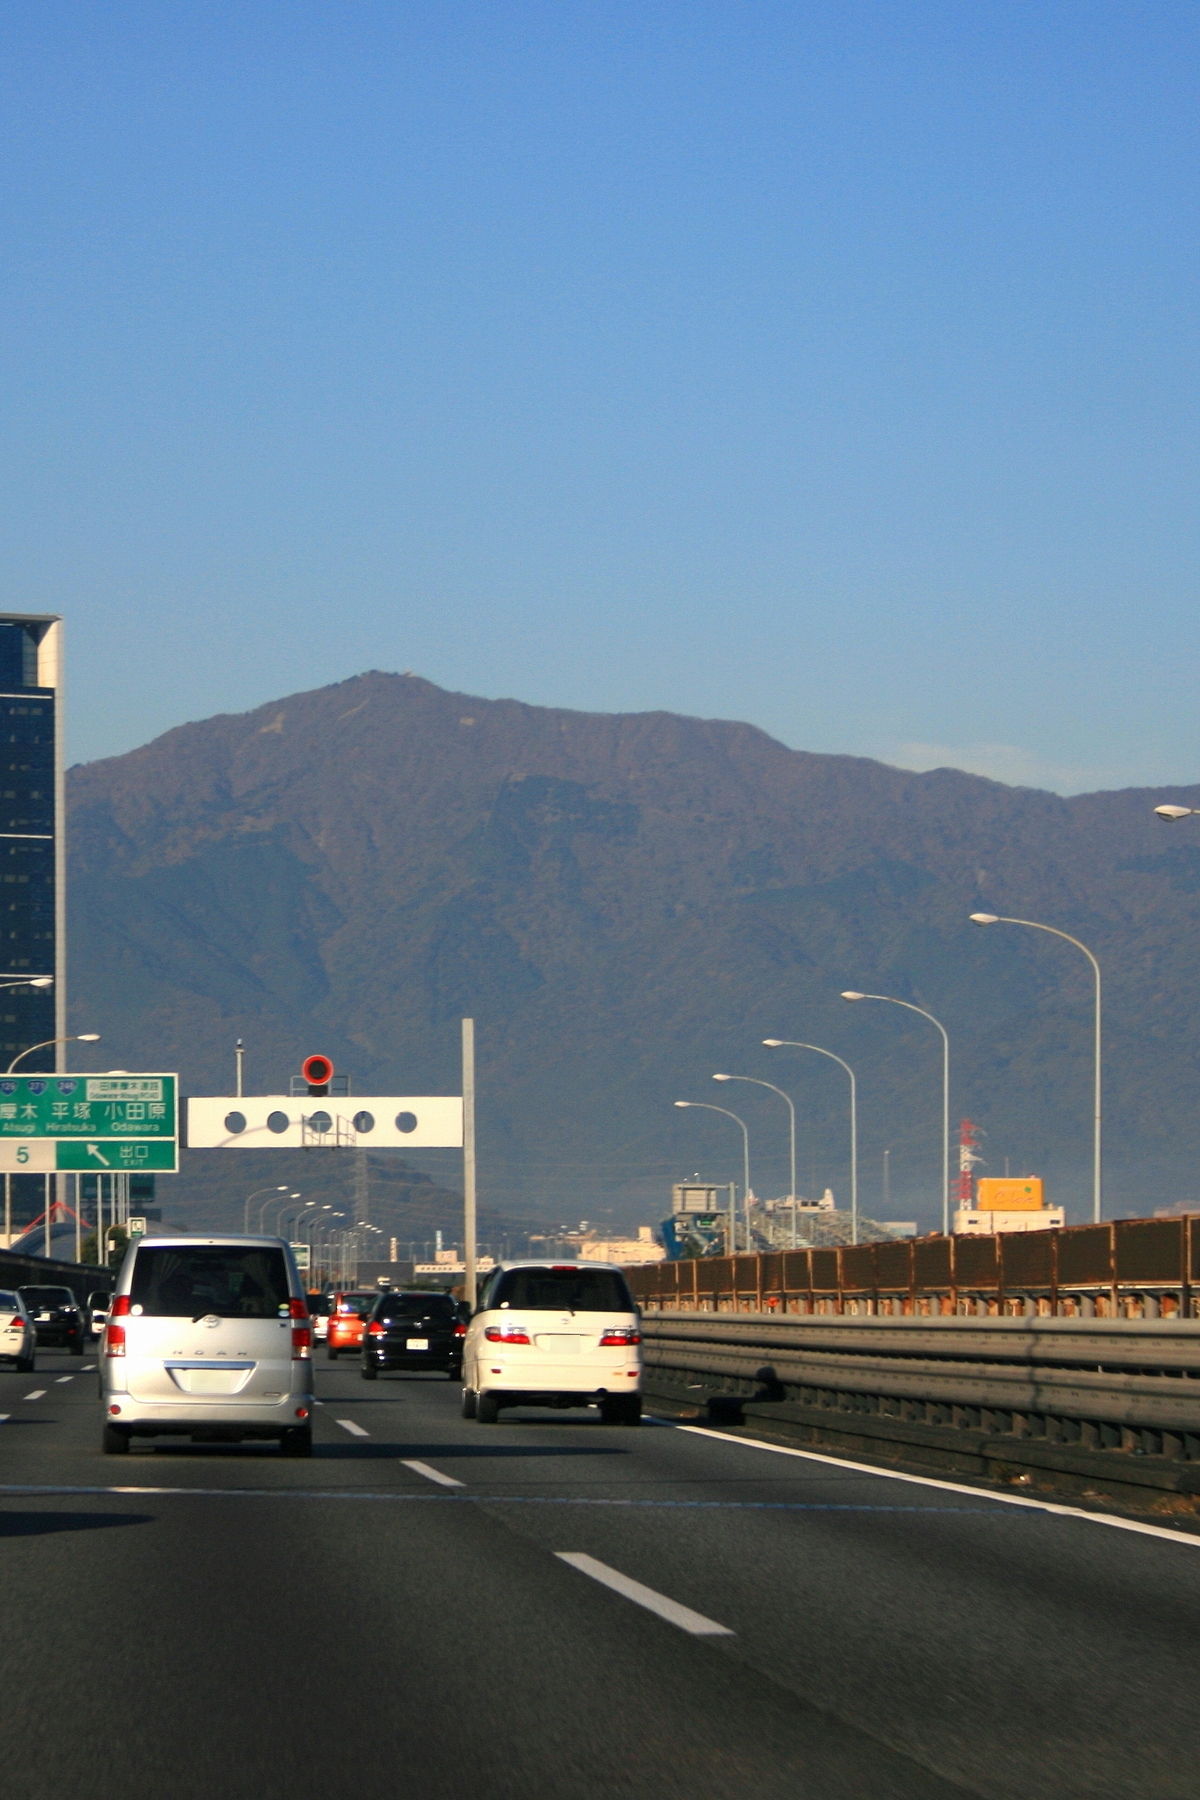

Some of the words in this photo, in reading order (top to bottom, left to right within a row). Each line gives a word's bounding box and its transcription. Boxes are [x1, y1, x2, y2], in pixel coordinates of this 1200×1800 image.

[51, 1102, 92, 1120] 平塚
[104, 1102, 167, 1120] 小田原
[2, 1122, 36, 1133] Atsugi
[45, 1121, 96, 1132] Hiratsuka
[110, 1121, 160, 1132] Odawara
[16, 1146, 30, 1164] 5
[119, 1145, 149, 1159] 出口
